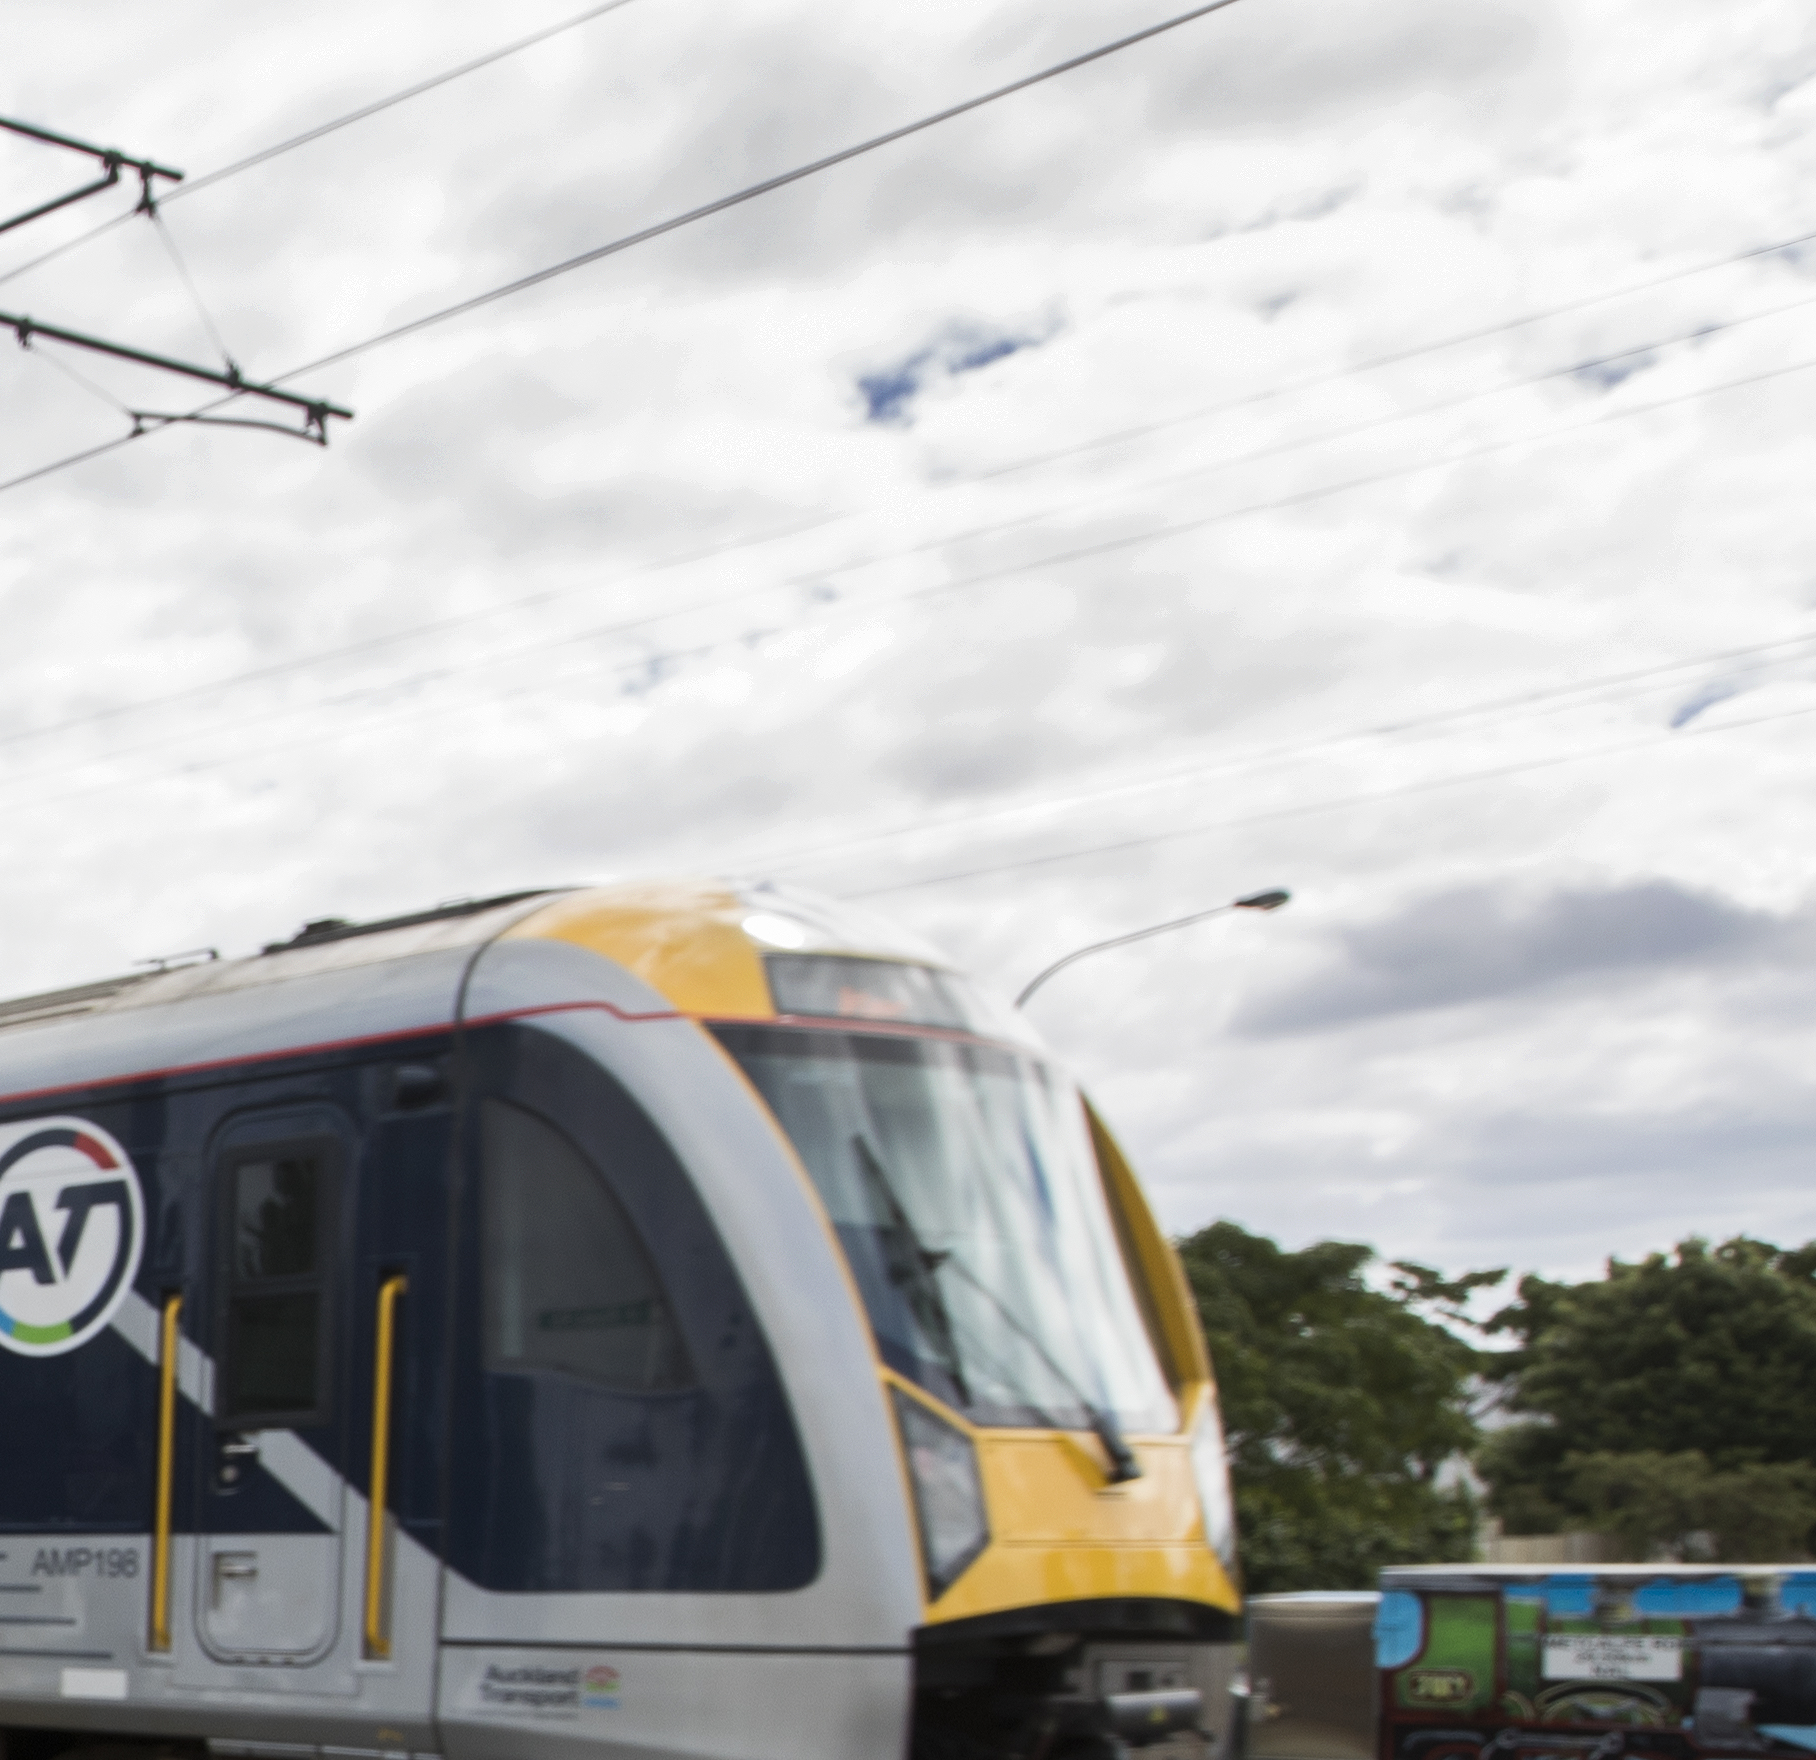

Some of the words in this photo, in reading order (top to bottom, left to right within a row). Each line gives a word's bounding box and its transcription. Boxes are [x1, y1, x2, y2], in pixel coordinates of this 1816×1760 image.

[30, 1546, 140, 1578] AMP198
[485, 1664, 580, 1685] Auckland
[480, 1682, 579, 1706] Transport
